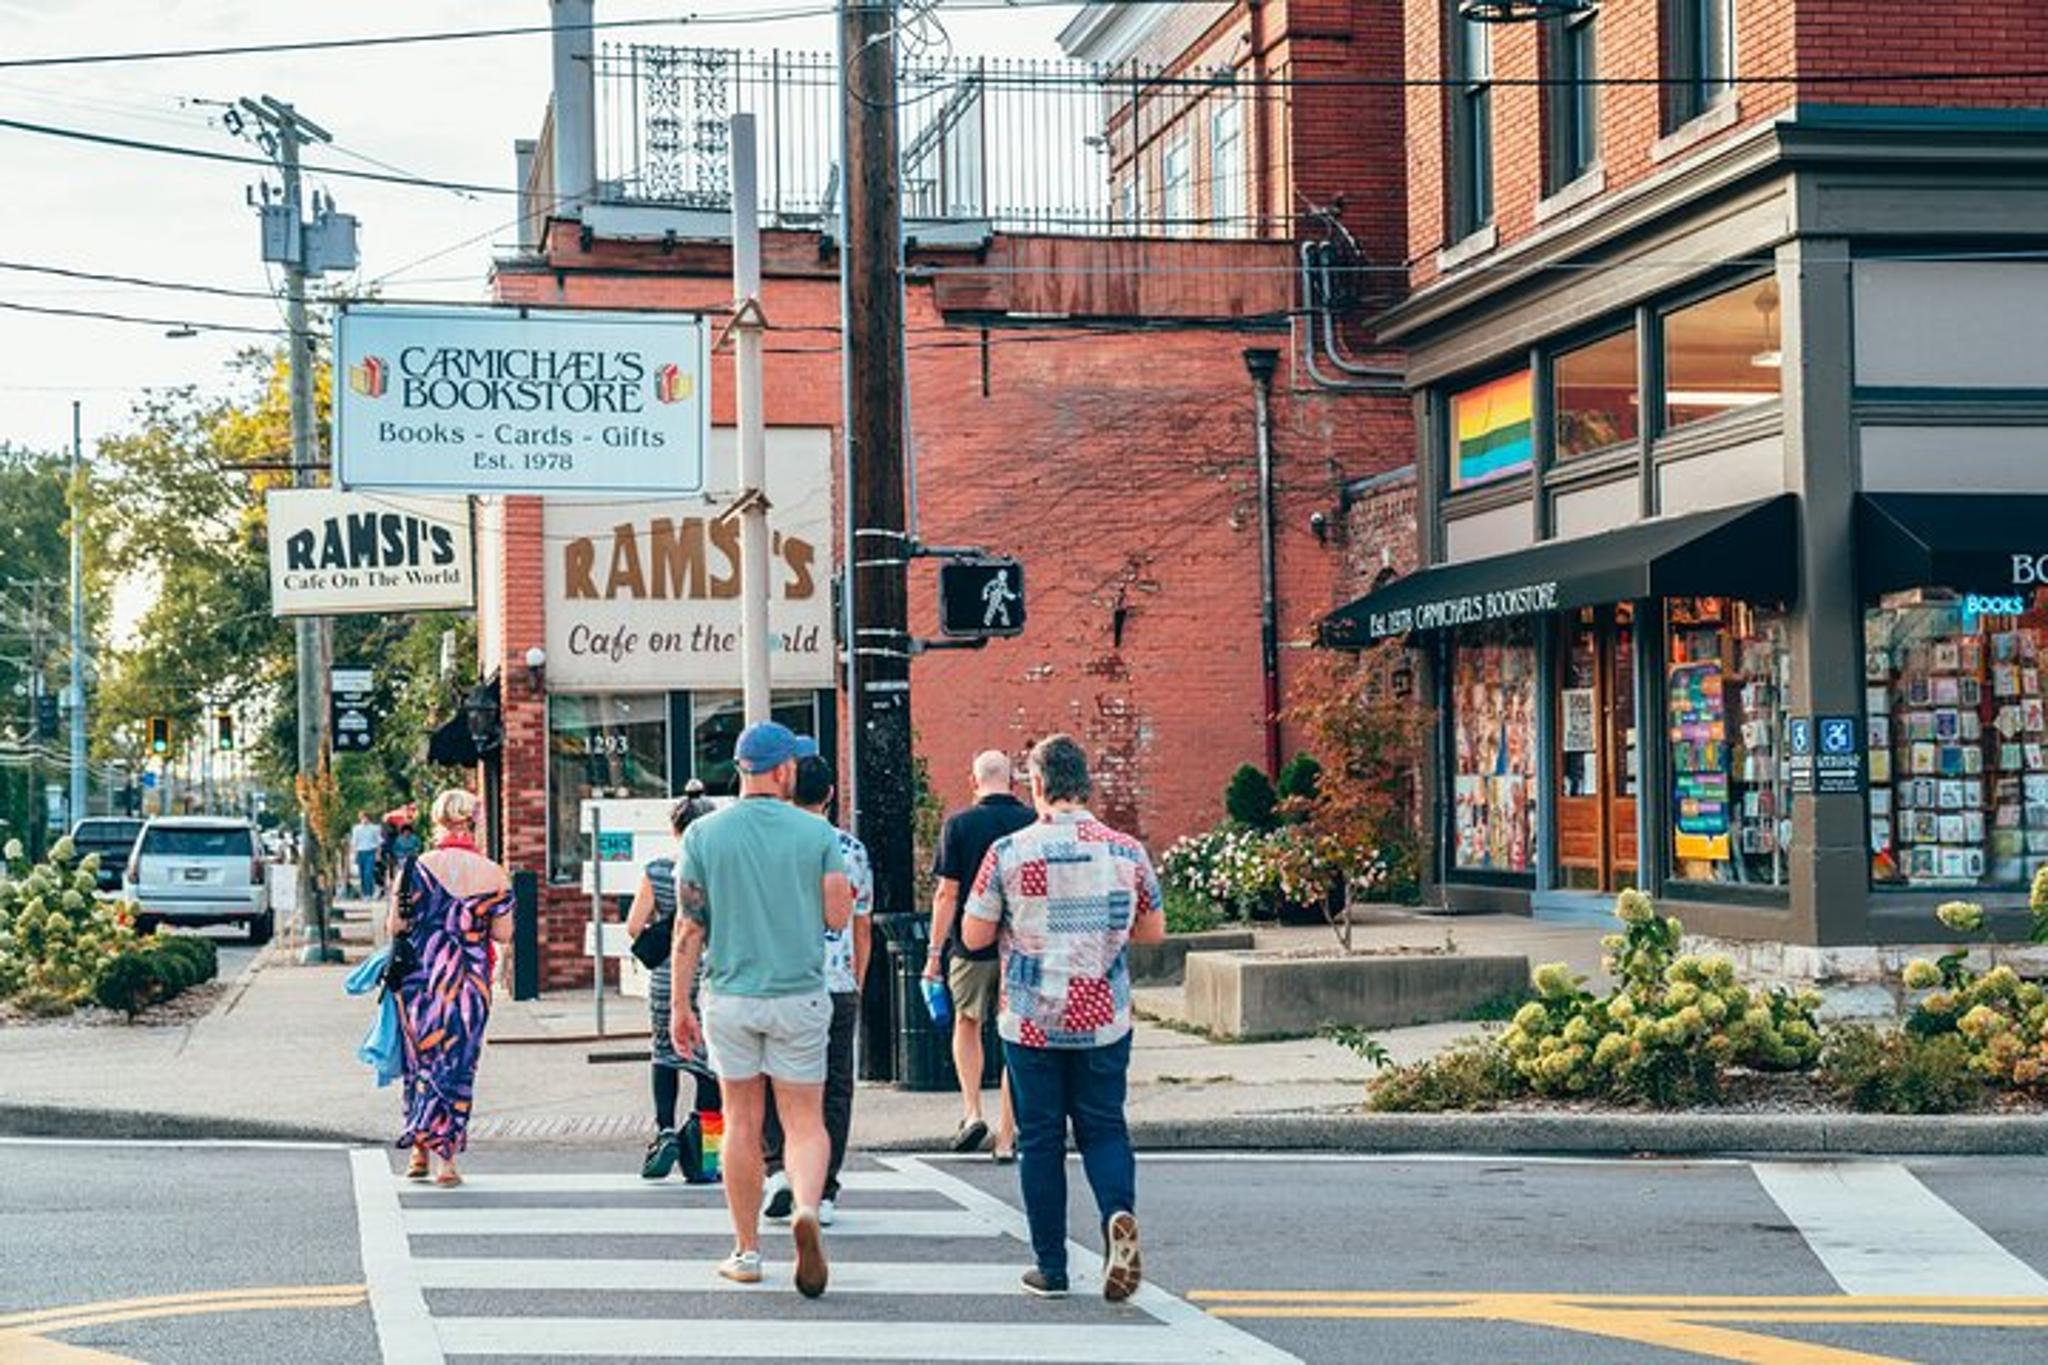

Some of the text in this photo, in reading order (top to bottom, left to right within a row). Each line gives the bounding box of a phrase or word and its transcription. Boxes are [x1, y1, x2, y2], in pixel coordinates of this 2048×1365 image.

[402, 379, 644, 413] BOOKSTORE
[379, 422, 465, 444] Books
[494, 423, 573, 446] Cards
[602, 425, 665, 448] Gifts
[473, 452, 573, 471] Est. 1978
[286, 512, 455, 570] RAMSI'S
[564, 517, 815, 600] RAMS'S
[284, 569, 461, 590] Cafe On The World
[1486, 581, 1558, 619] BOOKSTORE
[1966, 594, 2024, 615] BOOKS
[568, 624, 640, 662] Cafe
[649, 632, 683, 653] on
[690, 624, 736, 653] the
[584, 735, 629, 755] 1293
